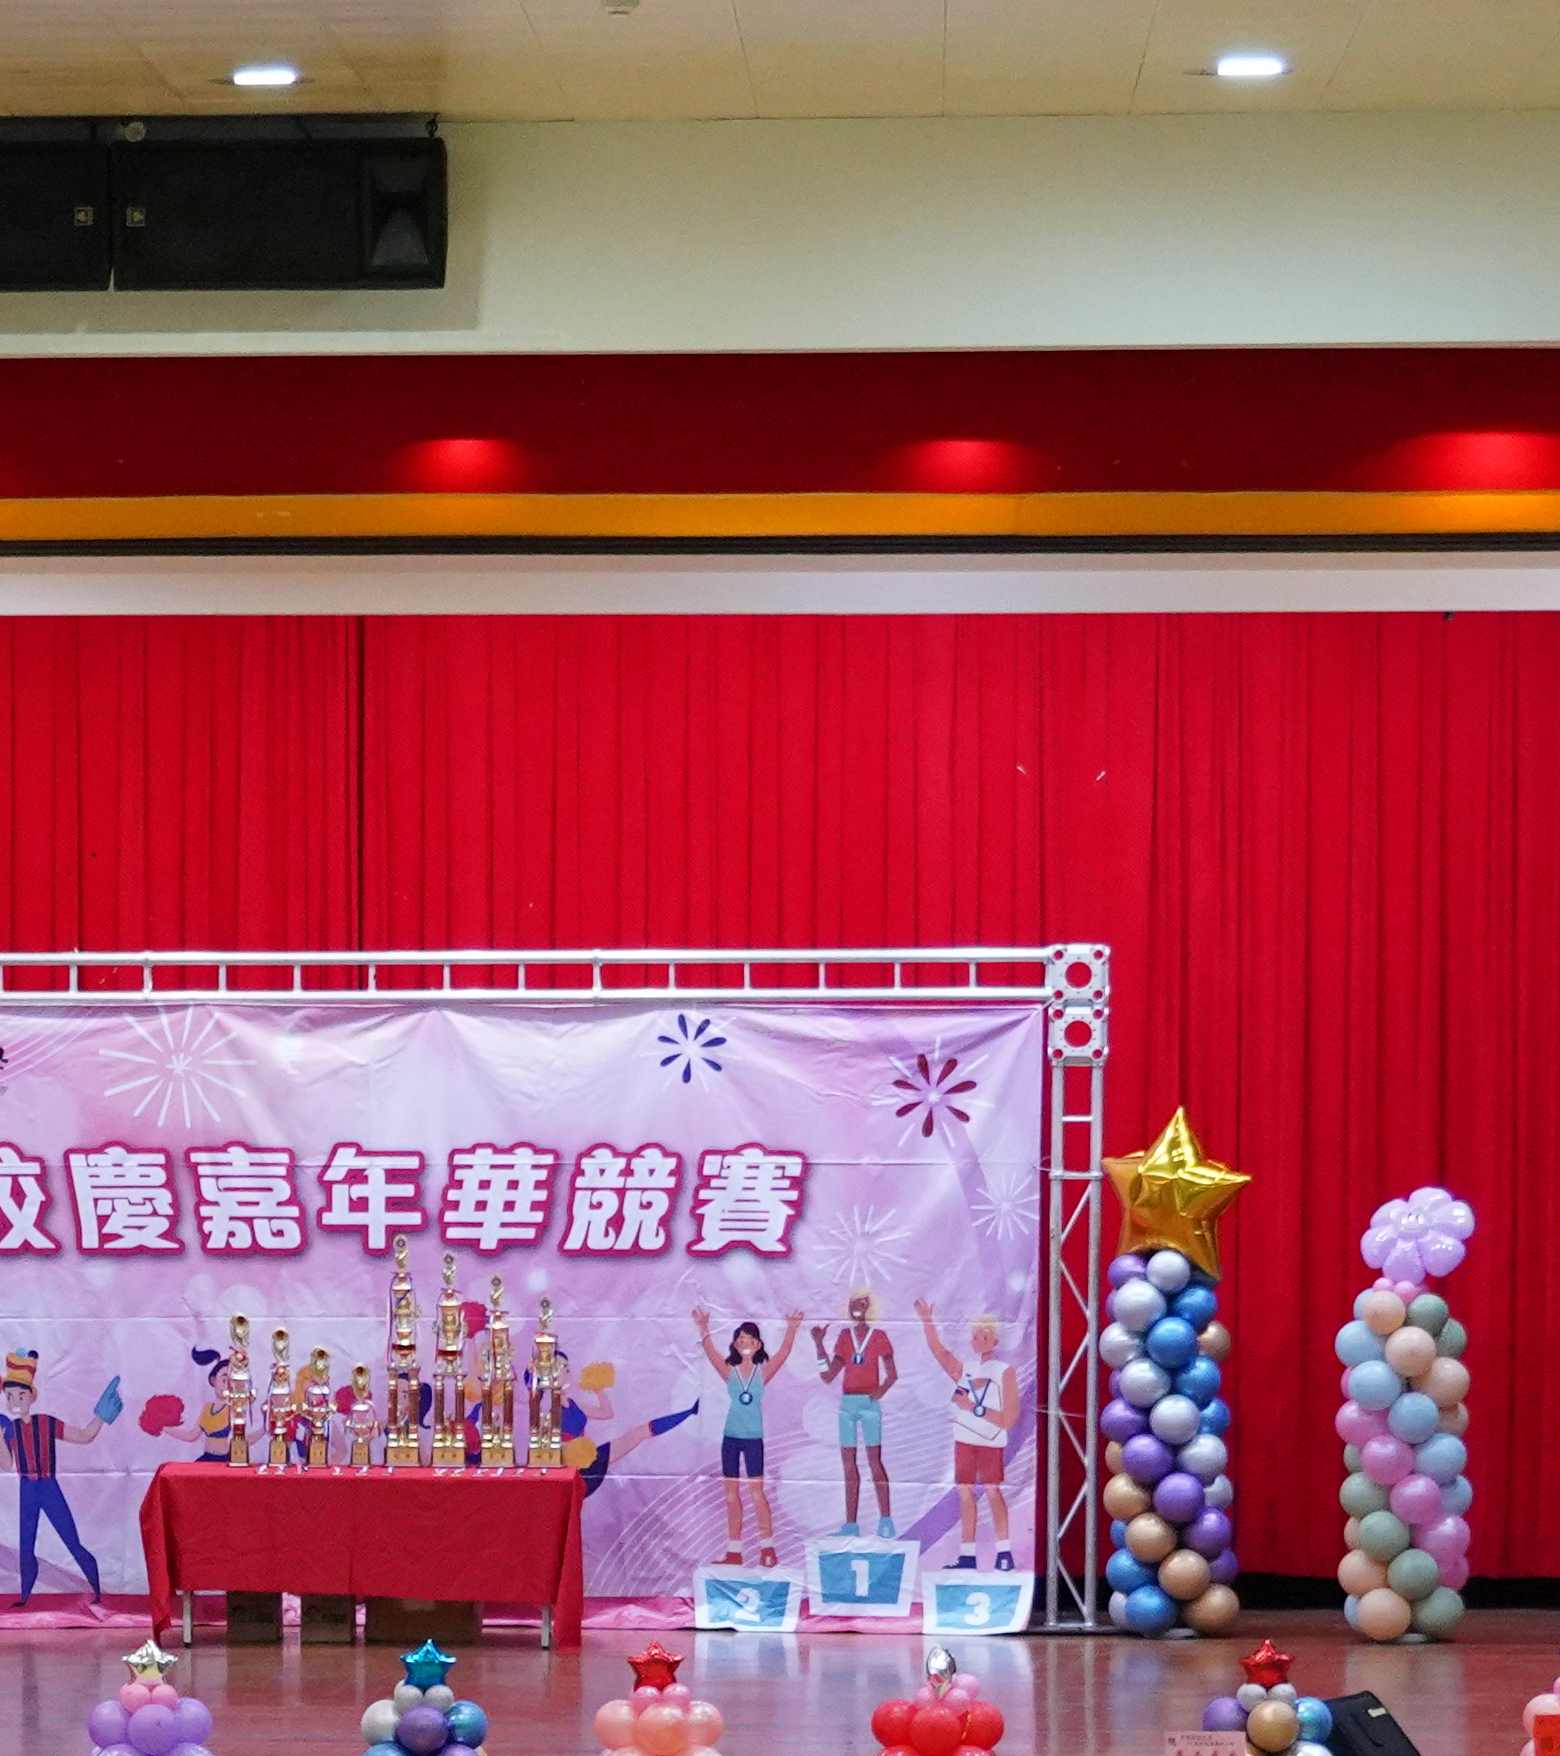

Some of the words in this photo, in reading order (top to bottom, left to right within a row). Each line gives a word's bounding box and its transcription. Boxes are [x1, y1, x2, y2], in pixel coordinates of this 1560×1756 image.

[851, 1559, 870, 1597] 1
[734, 1587, 762, 1622] 2
[965, 1592, 993, 1626] 3
